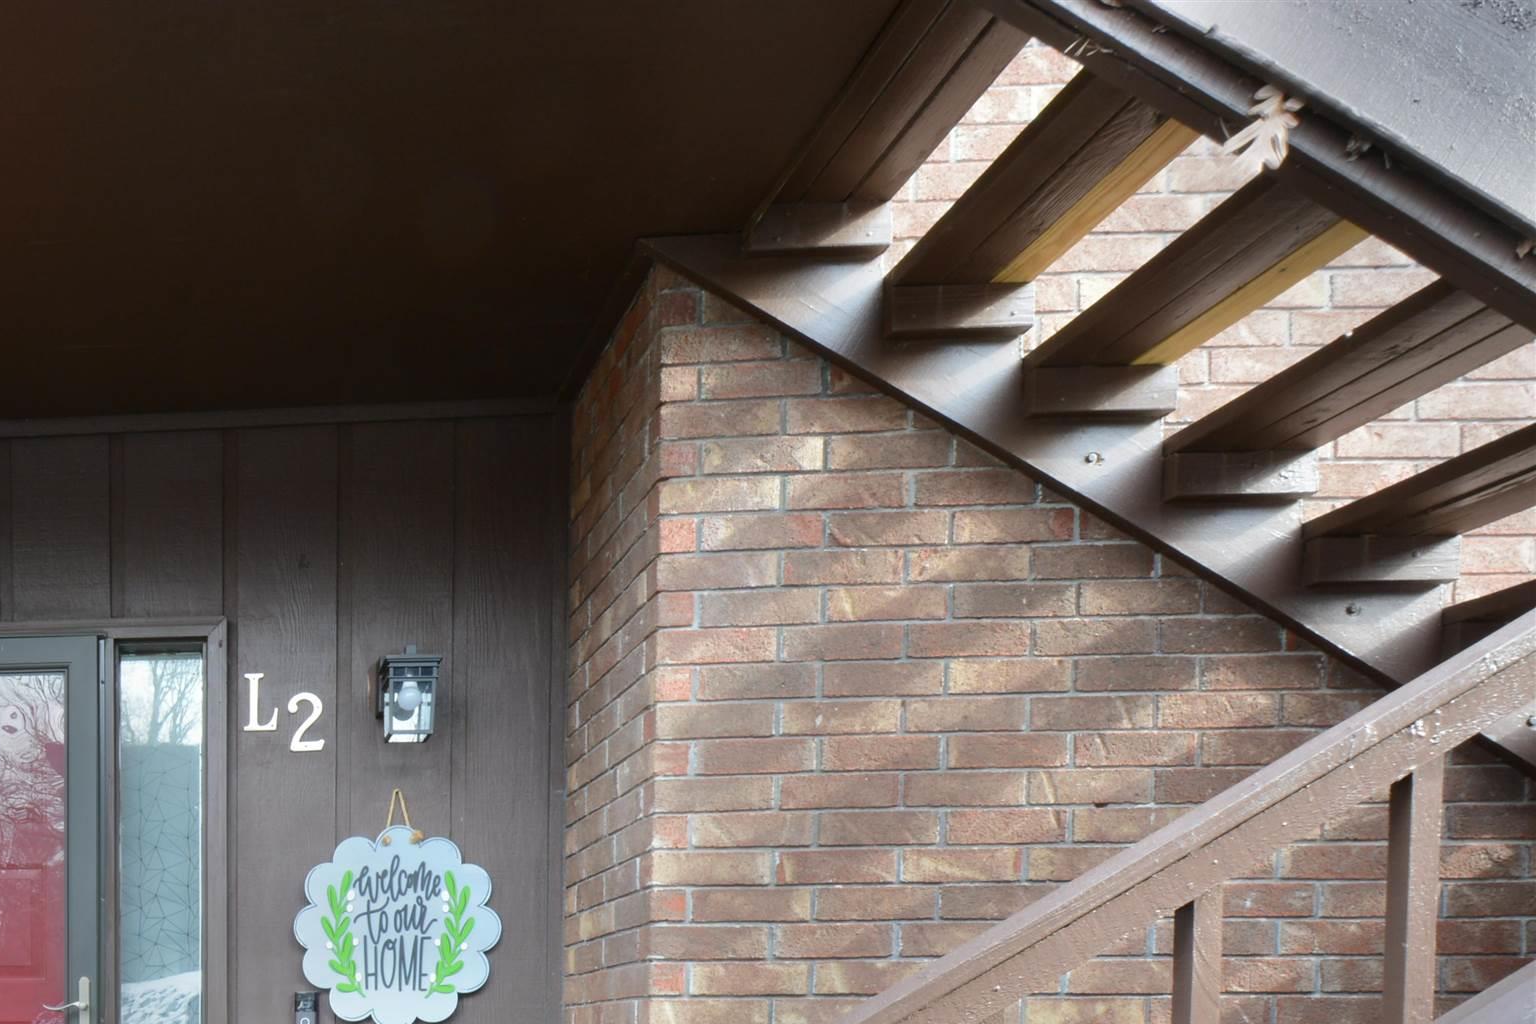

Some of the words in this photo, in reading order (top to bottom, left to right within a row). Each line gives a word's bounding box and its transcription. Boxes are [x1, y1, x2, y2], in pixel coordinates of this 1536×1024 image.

[353, 896, 390, 945] to
[394, 895, 438, 935] our
[364, 934, 432, 992] HOME
